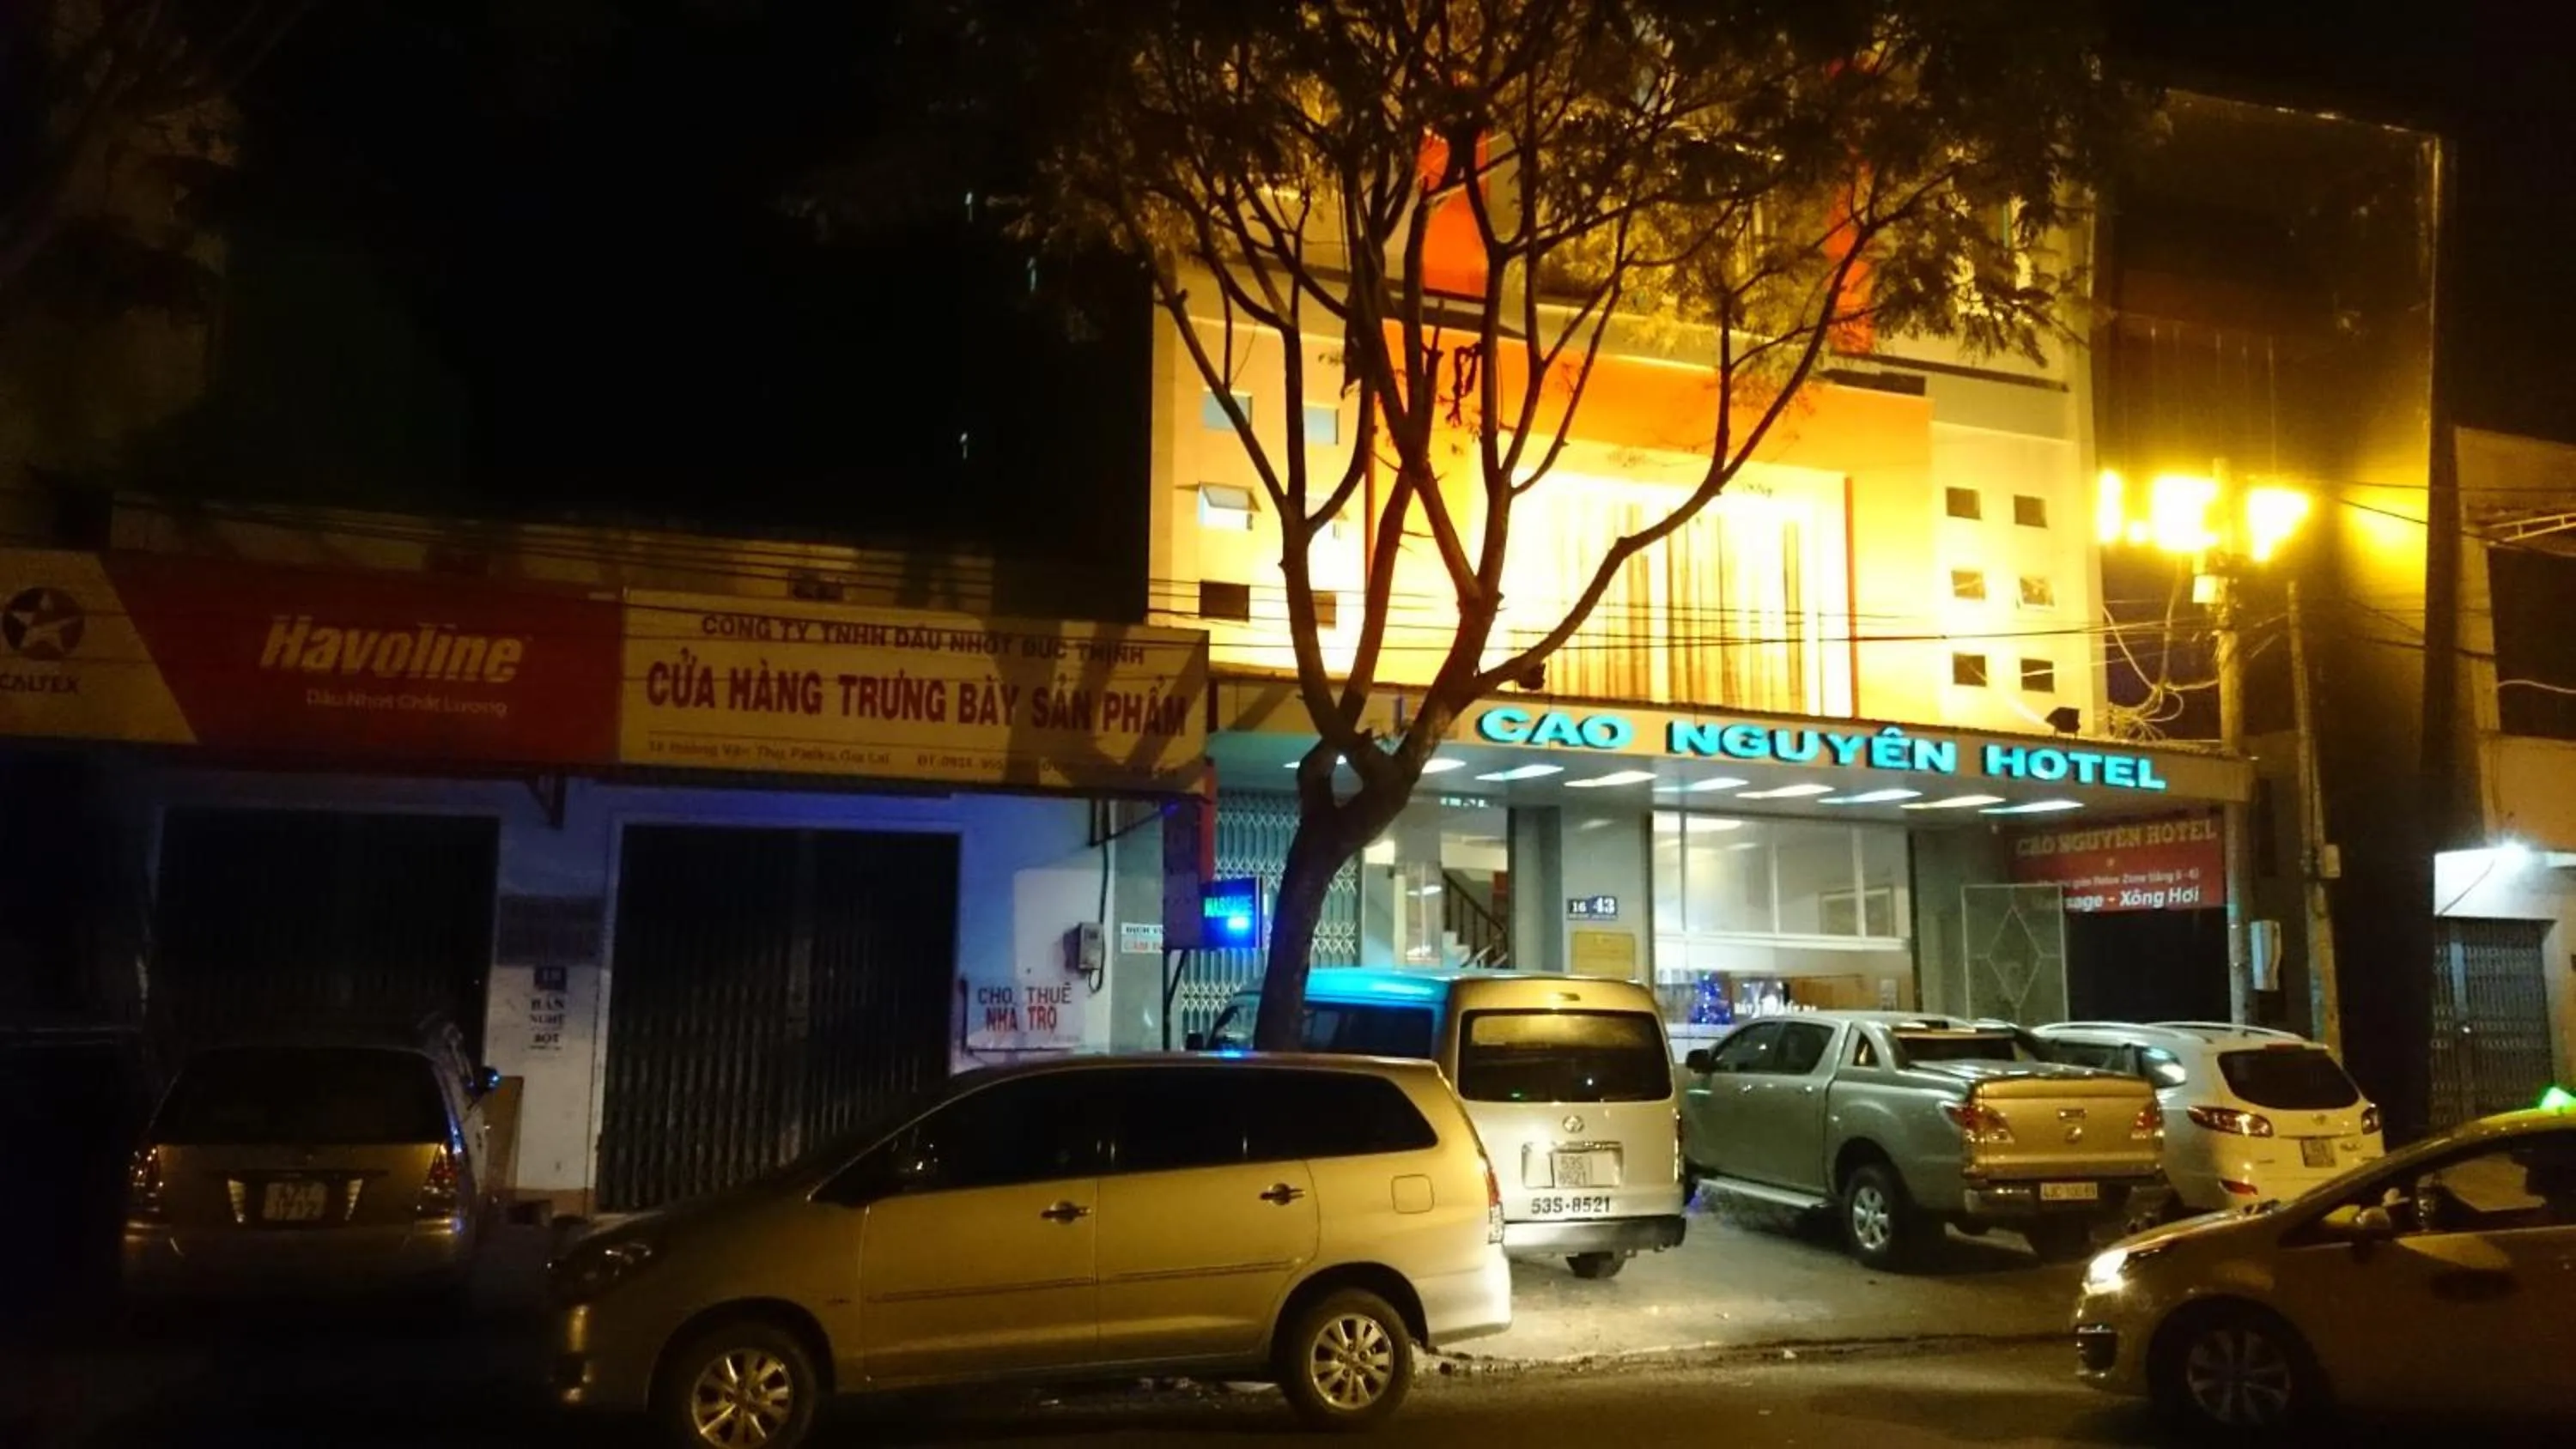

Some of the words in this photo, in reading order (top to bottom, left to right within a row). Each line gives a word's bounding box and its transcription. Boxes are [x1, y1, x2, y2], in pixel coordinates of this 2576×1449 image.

[260, 615, 523, 682] Havoline
[781, 621, 810, 642] TY
[822, 621, 886, 646] TNHH
[647, 647, 716, 708] CỬA
[728, 658, 823, 715] HÀNG
[838, 667, 946, 722] TRƯNG
[957, 675, 1021, 726] BÀY
[1031, 673, 1092, 731] SẢN
[1103, 675, 1187, 737] PHẨM
[1477, 706, 1633, 749] CAO
[1666, 719, 1957, 774] NGUYÊN
[1981, 743, 2166, 791] HOTEL
[2016, 835, 2056, 857] CAO
[2146, 818, 2218, 846] HOTEL
[1572, 900, 1587, 912] 16
[1593, 896, 1615, 914] 43
[2119, 888, 2165, 908] Xông
[977, 986, 1013, 1004] CHO
[1026, 982, 1072, 1003] THUÊ
